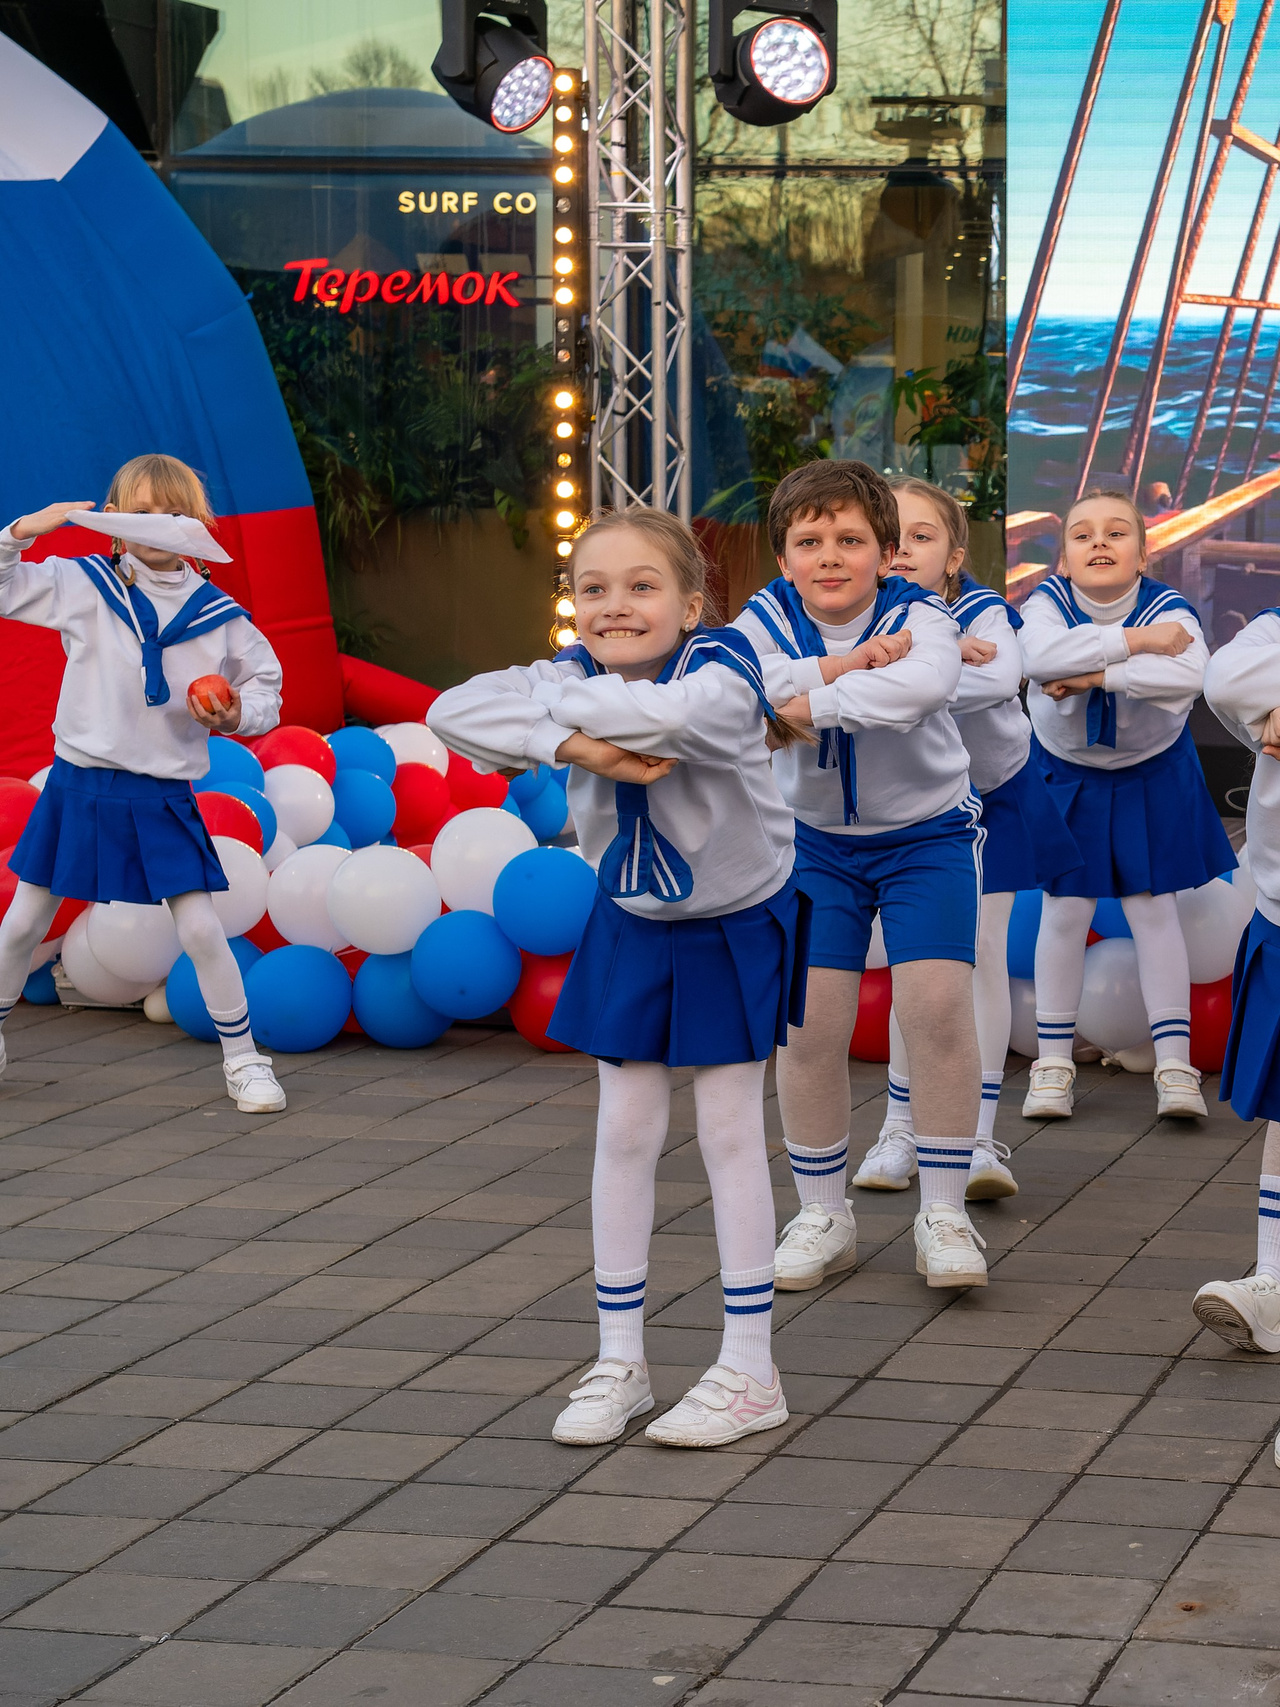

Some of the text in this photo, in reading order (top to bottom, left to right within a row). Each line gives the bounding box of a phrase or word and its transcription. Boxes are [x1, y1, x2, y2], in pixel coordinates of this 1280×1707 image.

[398, 190, 537, 214] SURF CO
[283, 257, 521, 314] Теремок
